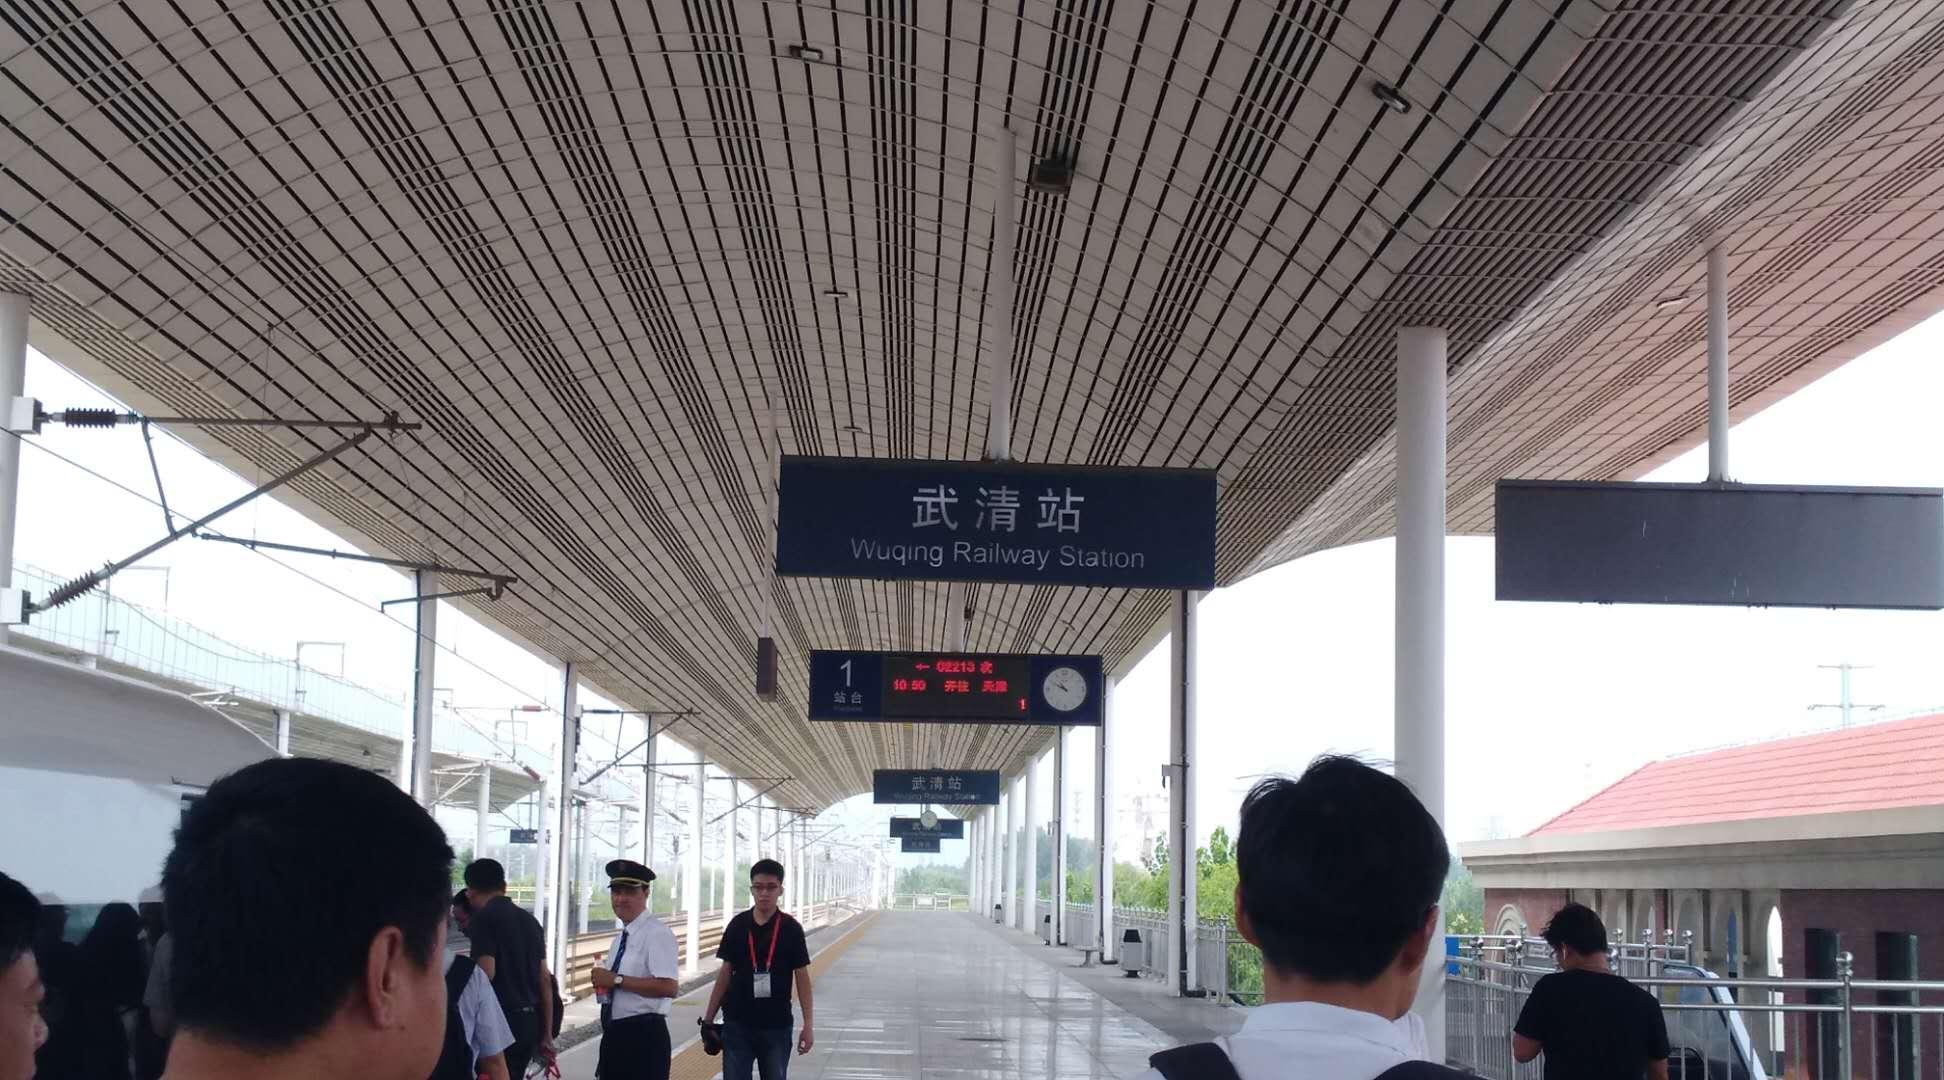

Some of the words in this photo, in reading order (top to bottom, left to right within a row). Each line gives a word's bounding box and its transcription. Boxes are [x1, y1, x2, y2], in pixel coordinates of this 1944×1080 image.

[912, 483, 1086, 534] 武清站
[850, 537, 944, 568] Wuqing
[953, 541, 1050, 572] Railway
[1058, 545, 1146, 569] Station
[840, 659, 852, 687] 1
[833, 690, 863, 704] 站台
[1019, 698, 1027, 711] 1
[911, 775, 962, 791] 武清站
